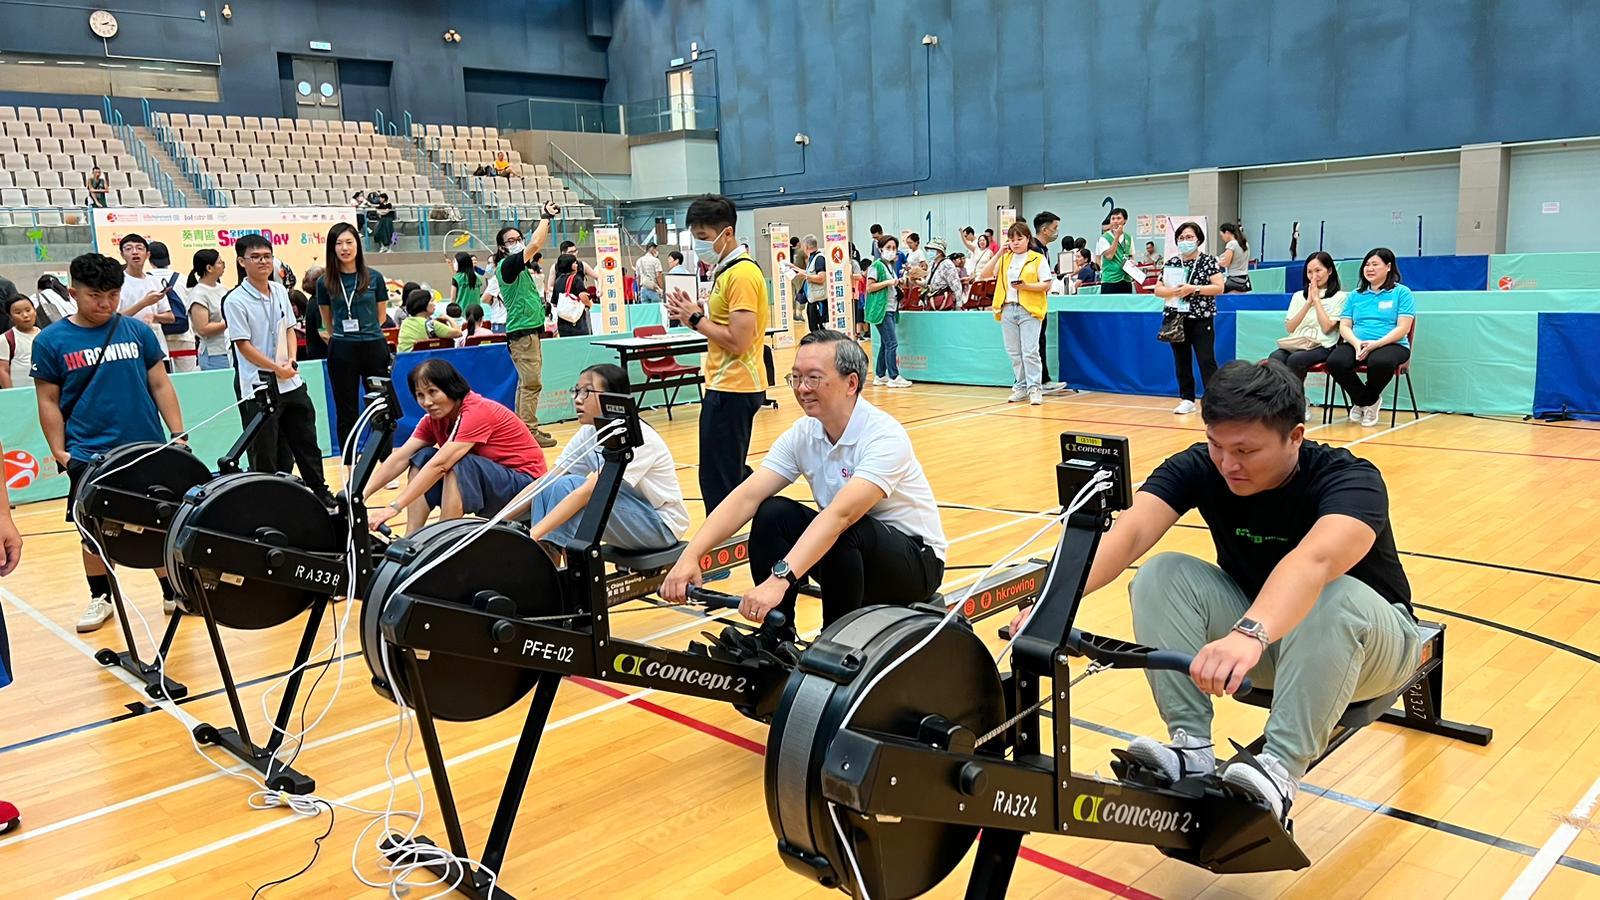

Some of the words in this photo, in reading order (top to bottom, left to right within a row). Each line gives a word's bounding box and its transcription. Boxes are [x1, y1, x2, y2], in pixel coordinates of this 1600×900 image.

[926, 211, 931, 244] 1
[1102, 197, 1114, 235] 2
[1077, 445, 1111, 455] concept
[295, 565, 340, 586] RA338
[996, 577, 1035, 601] hkrowing
[521, 639, 574, 663] PF-E-02
[645, 660, 733, 691] concept
[733, 676, 747, 693] 2
[1410, 683, 1427, 720] RA337
[993, 790, 1038, 818] RA324
[1102, 801, 1179, 833] concept
[1181, 811, 1192, 833] 2
